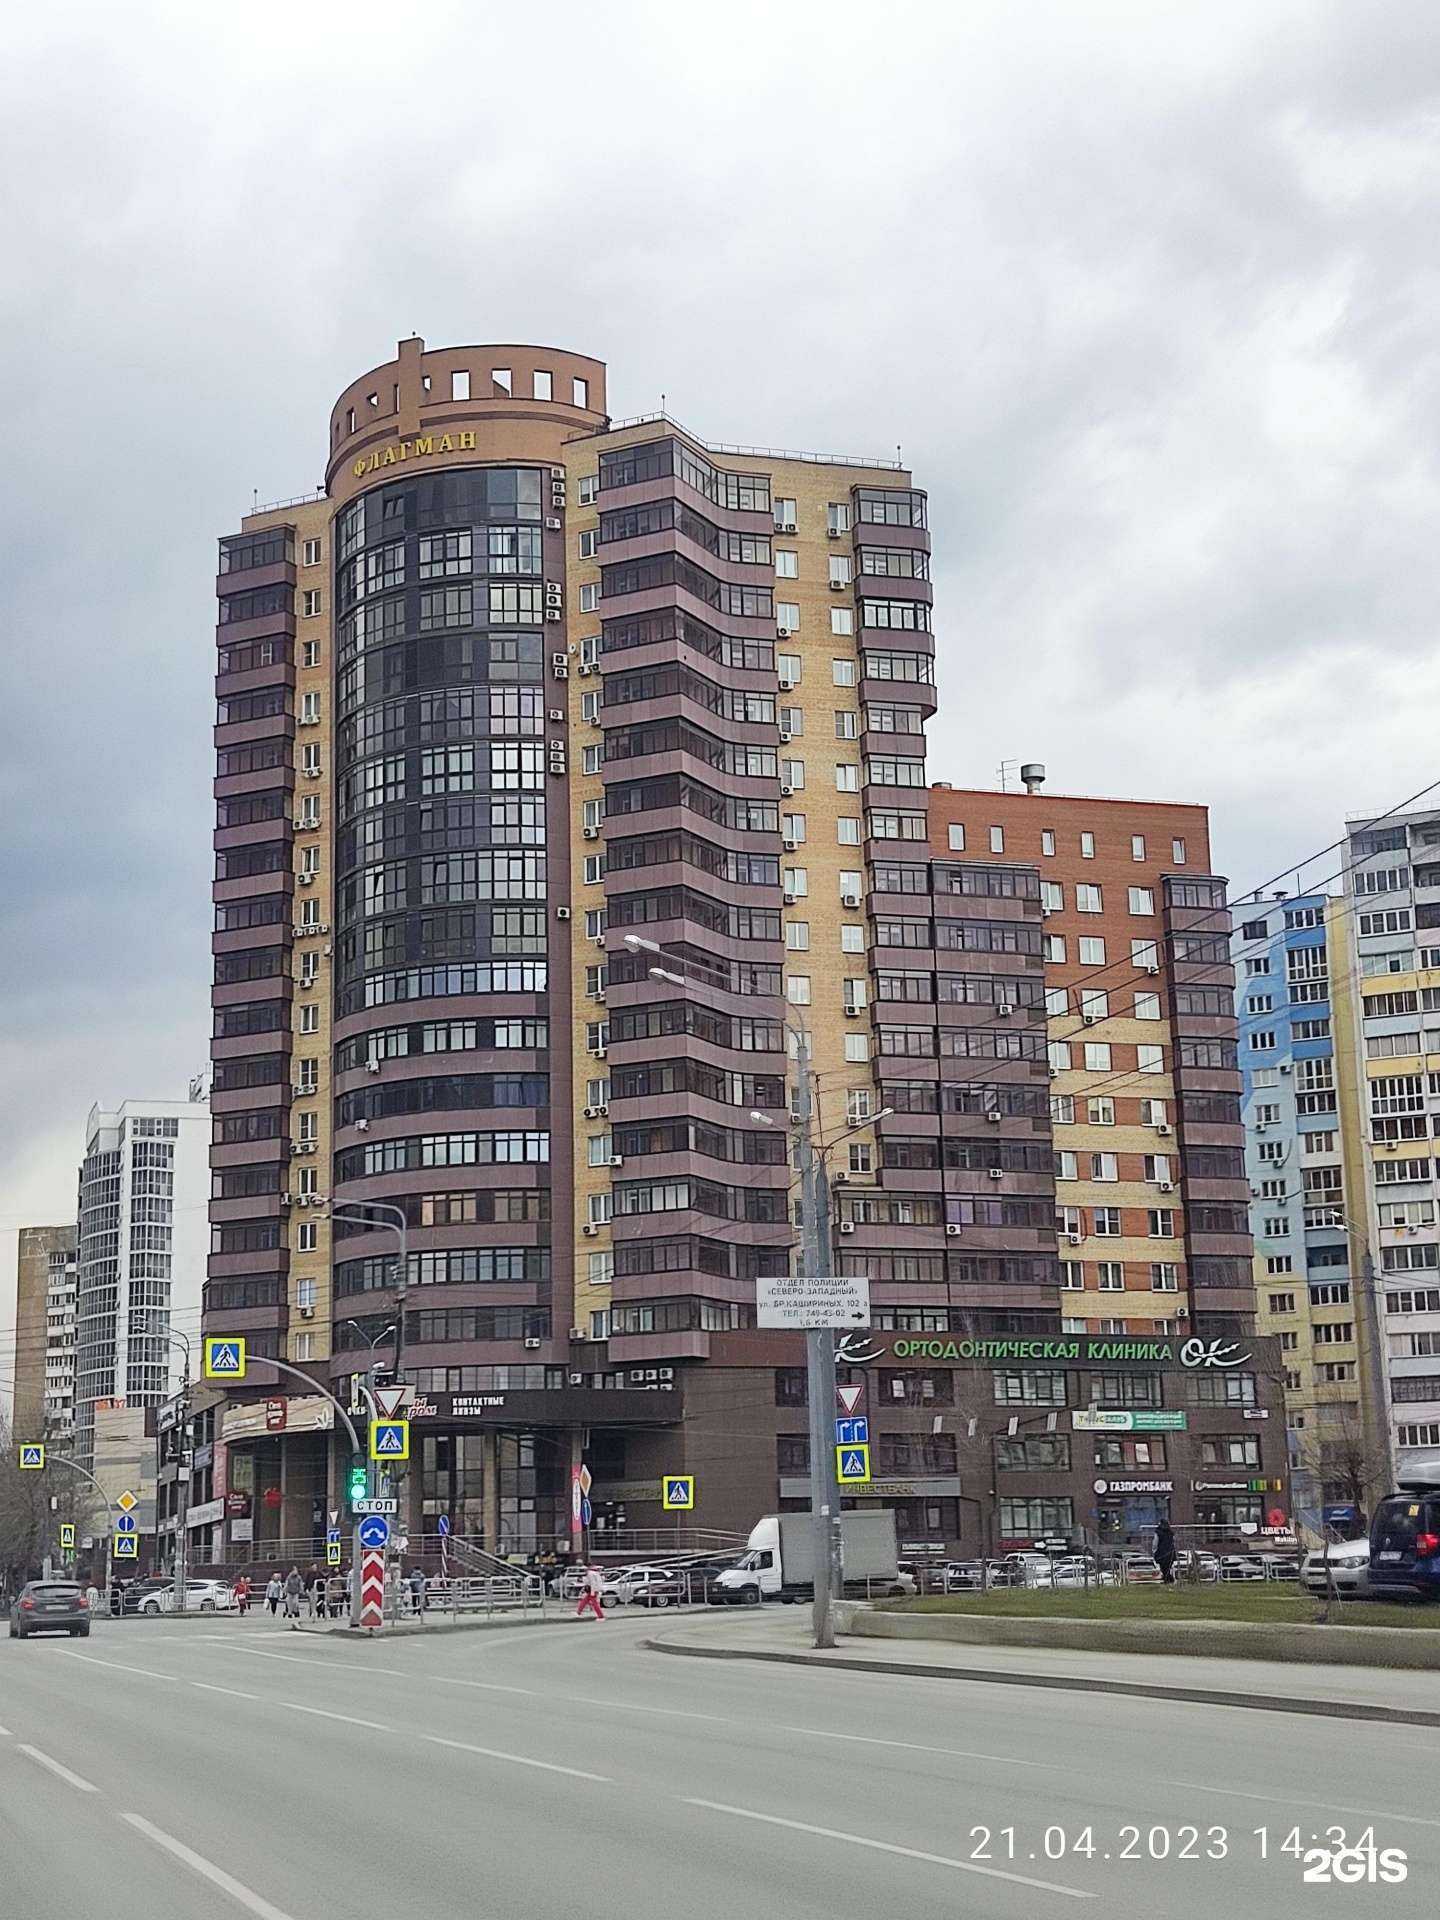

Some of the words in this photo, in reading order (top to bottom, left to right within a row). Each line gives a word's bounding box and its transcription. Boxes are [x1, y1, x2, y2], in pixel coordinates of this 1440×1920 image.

[353, 432, 477, 477] ФЛАГМАН
[776, 1279, 804, 1287] ОТДЕЛ
[808, 1279, 849, 1287] ПОЛИЦИИ
[893, 1339, 1080, 1360] ОРТОДОНТИЧЕСКАЯ
[1088, 1342, 1173, 1361] КЛИНИКА
[452, 1396, 505, 1407] КОНТАКТНЫЕ
[452, 1407, 481, 1416] ЛИНЗЫ
[1109, 1481, 1174, 1492] ГАЗПРОМБАНК
[357, 1500, 393, 1511] СТОП
[1260, 1526, 1294, 1535] ЦВЕТЫ
